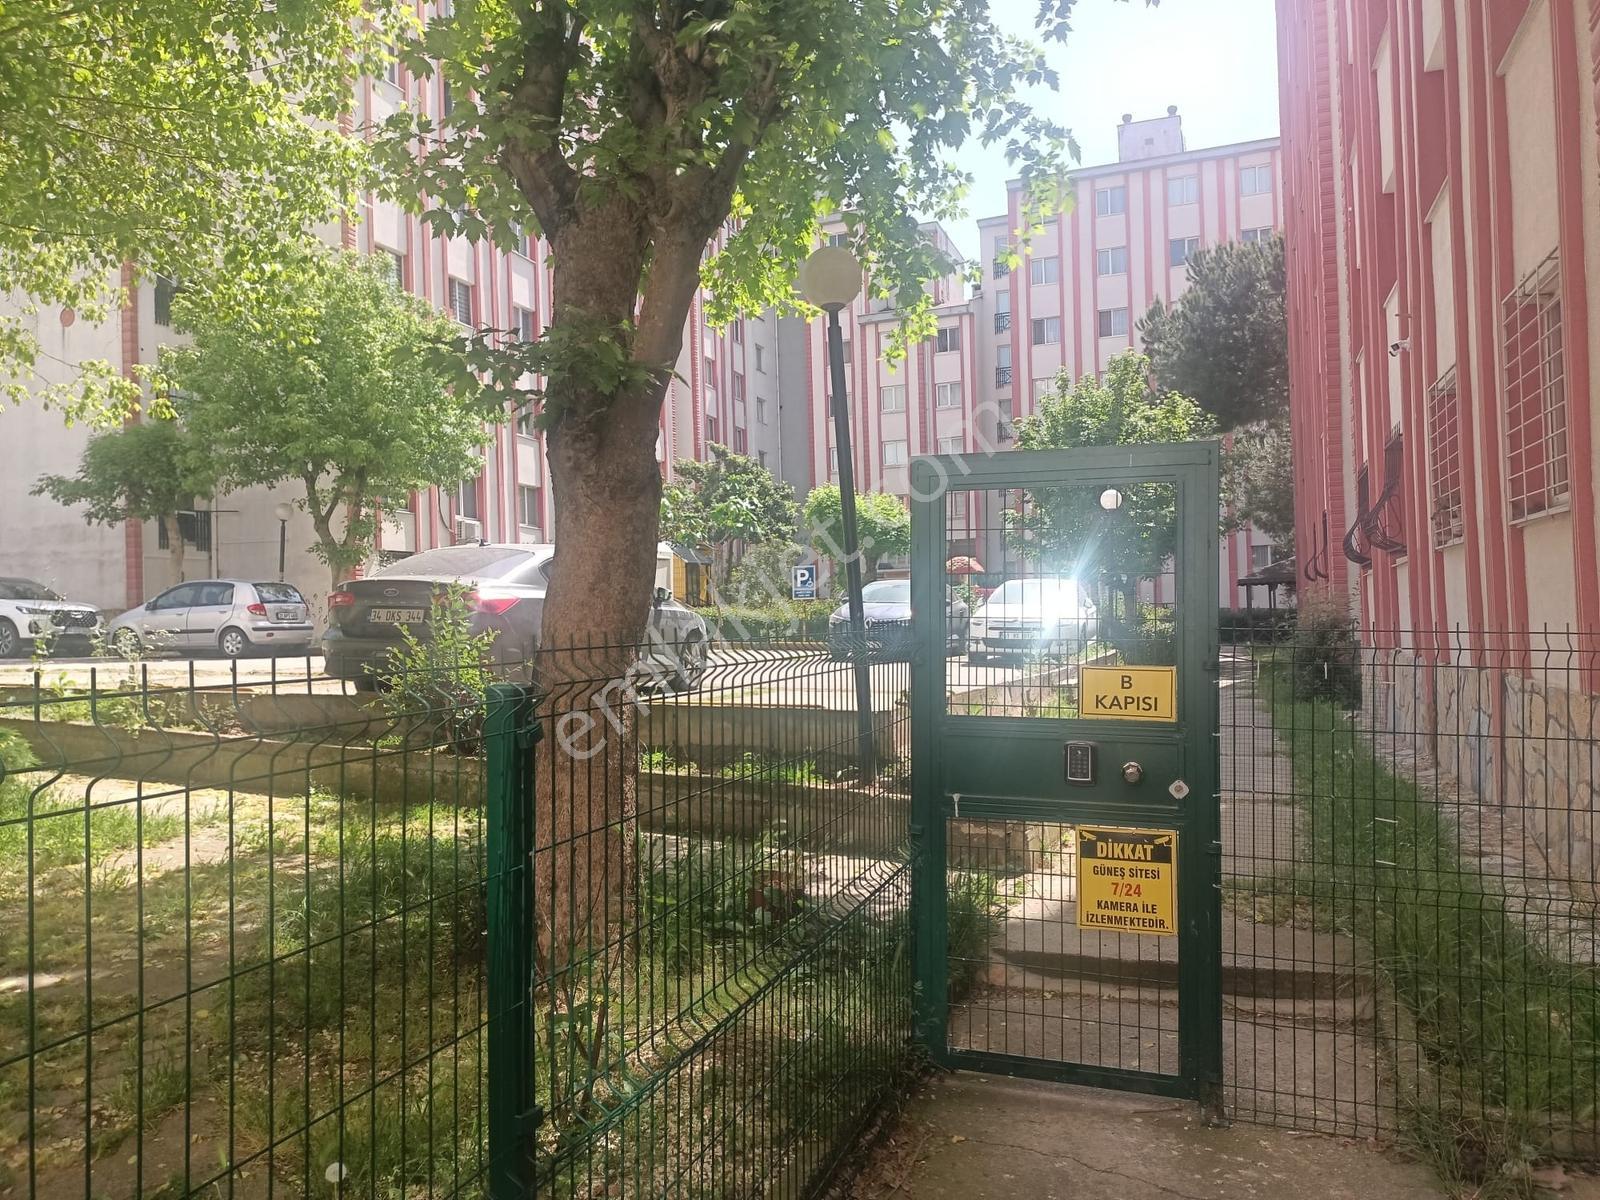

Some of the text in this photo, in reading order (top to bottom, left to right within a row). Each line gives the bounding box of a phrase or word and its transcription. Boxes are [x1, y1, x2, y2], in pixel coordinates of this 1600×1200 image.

[797, 570, 809, 587] P
[371, 610, 382, 621] 34
[405, 611, 422, 621] 344
[1120, 674, 1133, 690] B
[1095, 694, 1158, 712] KAPISI
[1097, 839, 1154, 861] DİKKAT
[1092, 863, 1160, 880] GÜNEŞ SİTESİ
[1111, 882, 1142, 898] 7/24
[1097, 899, 1158, 914] KAMERA İLE
[1086, 911, 1169, 929] İZLENMEKTEDİR.
